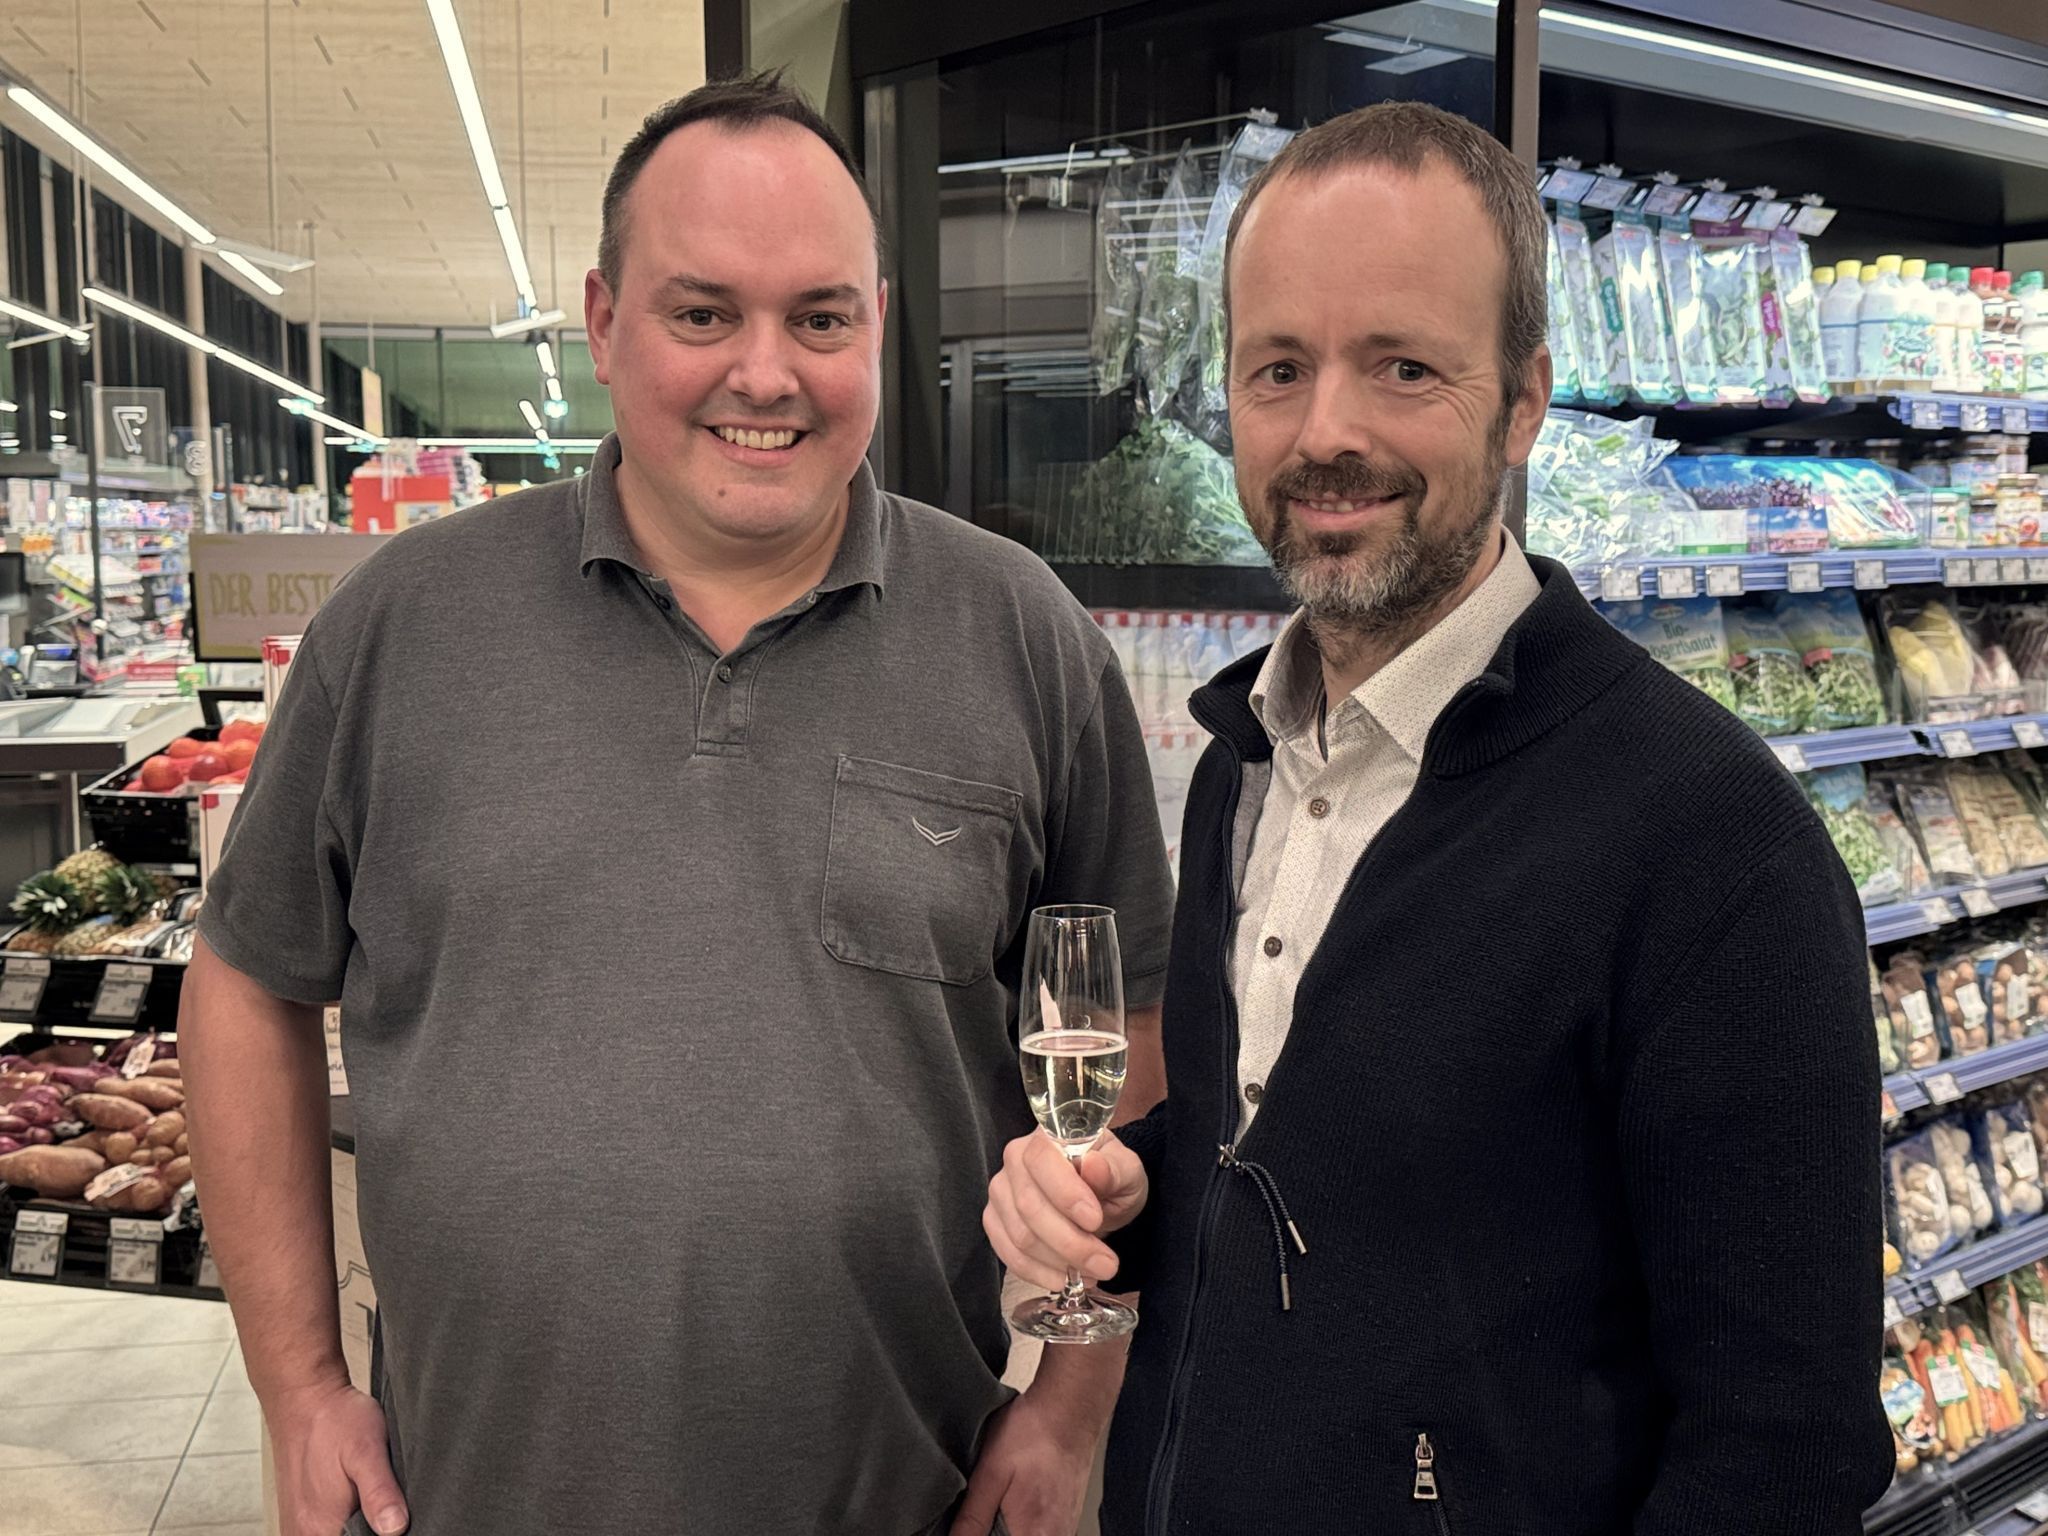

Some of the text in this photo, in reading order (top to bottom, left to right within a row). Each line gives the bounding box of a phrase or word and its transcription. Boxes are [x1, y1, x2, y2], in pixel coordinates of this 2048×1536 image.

[112, 405, 148, 454] 7
[207, 571, 257, 618] DER
[1662, 622, 1690, 640] Bio-
